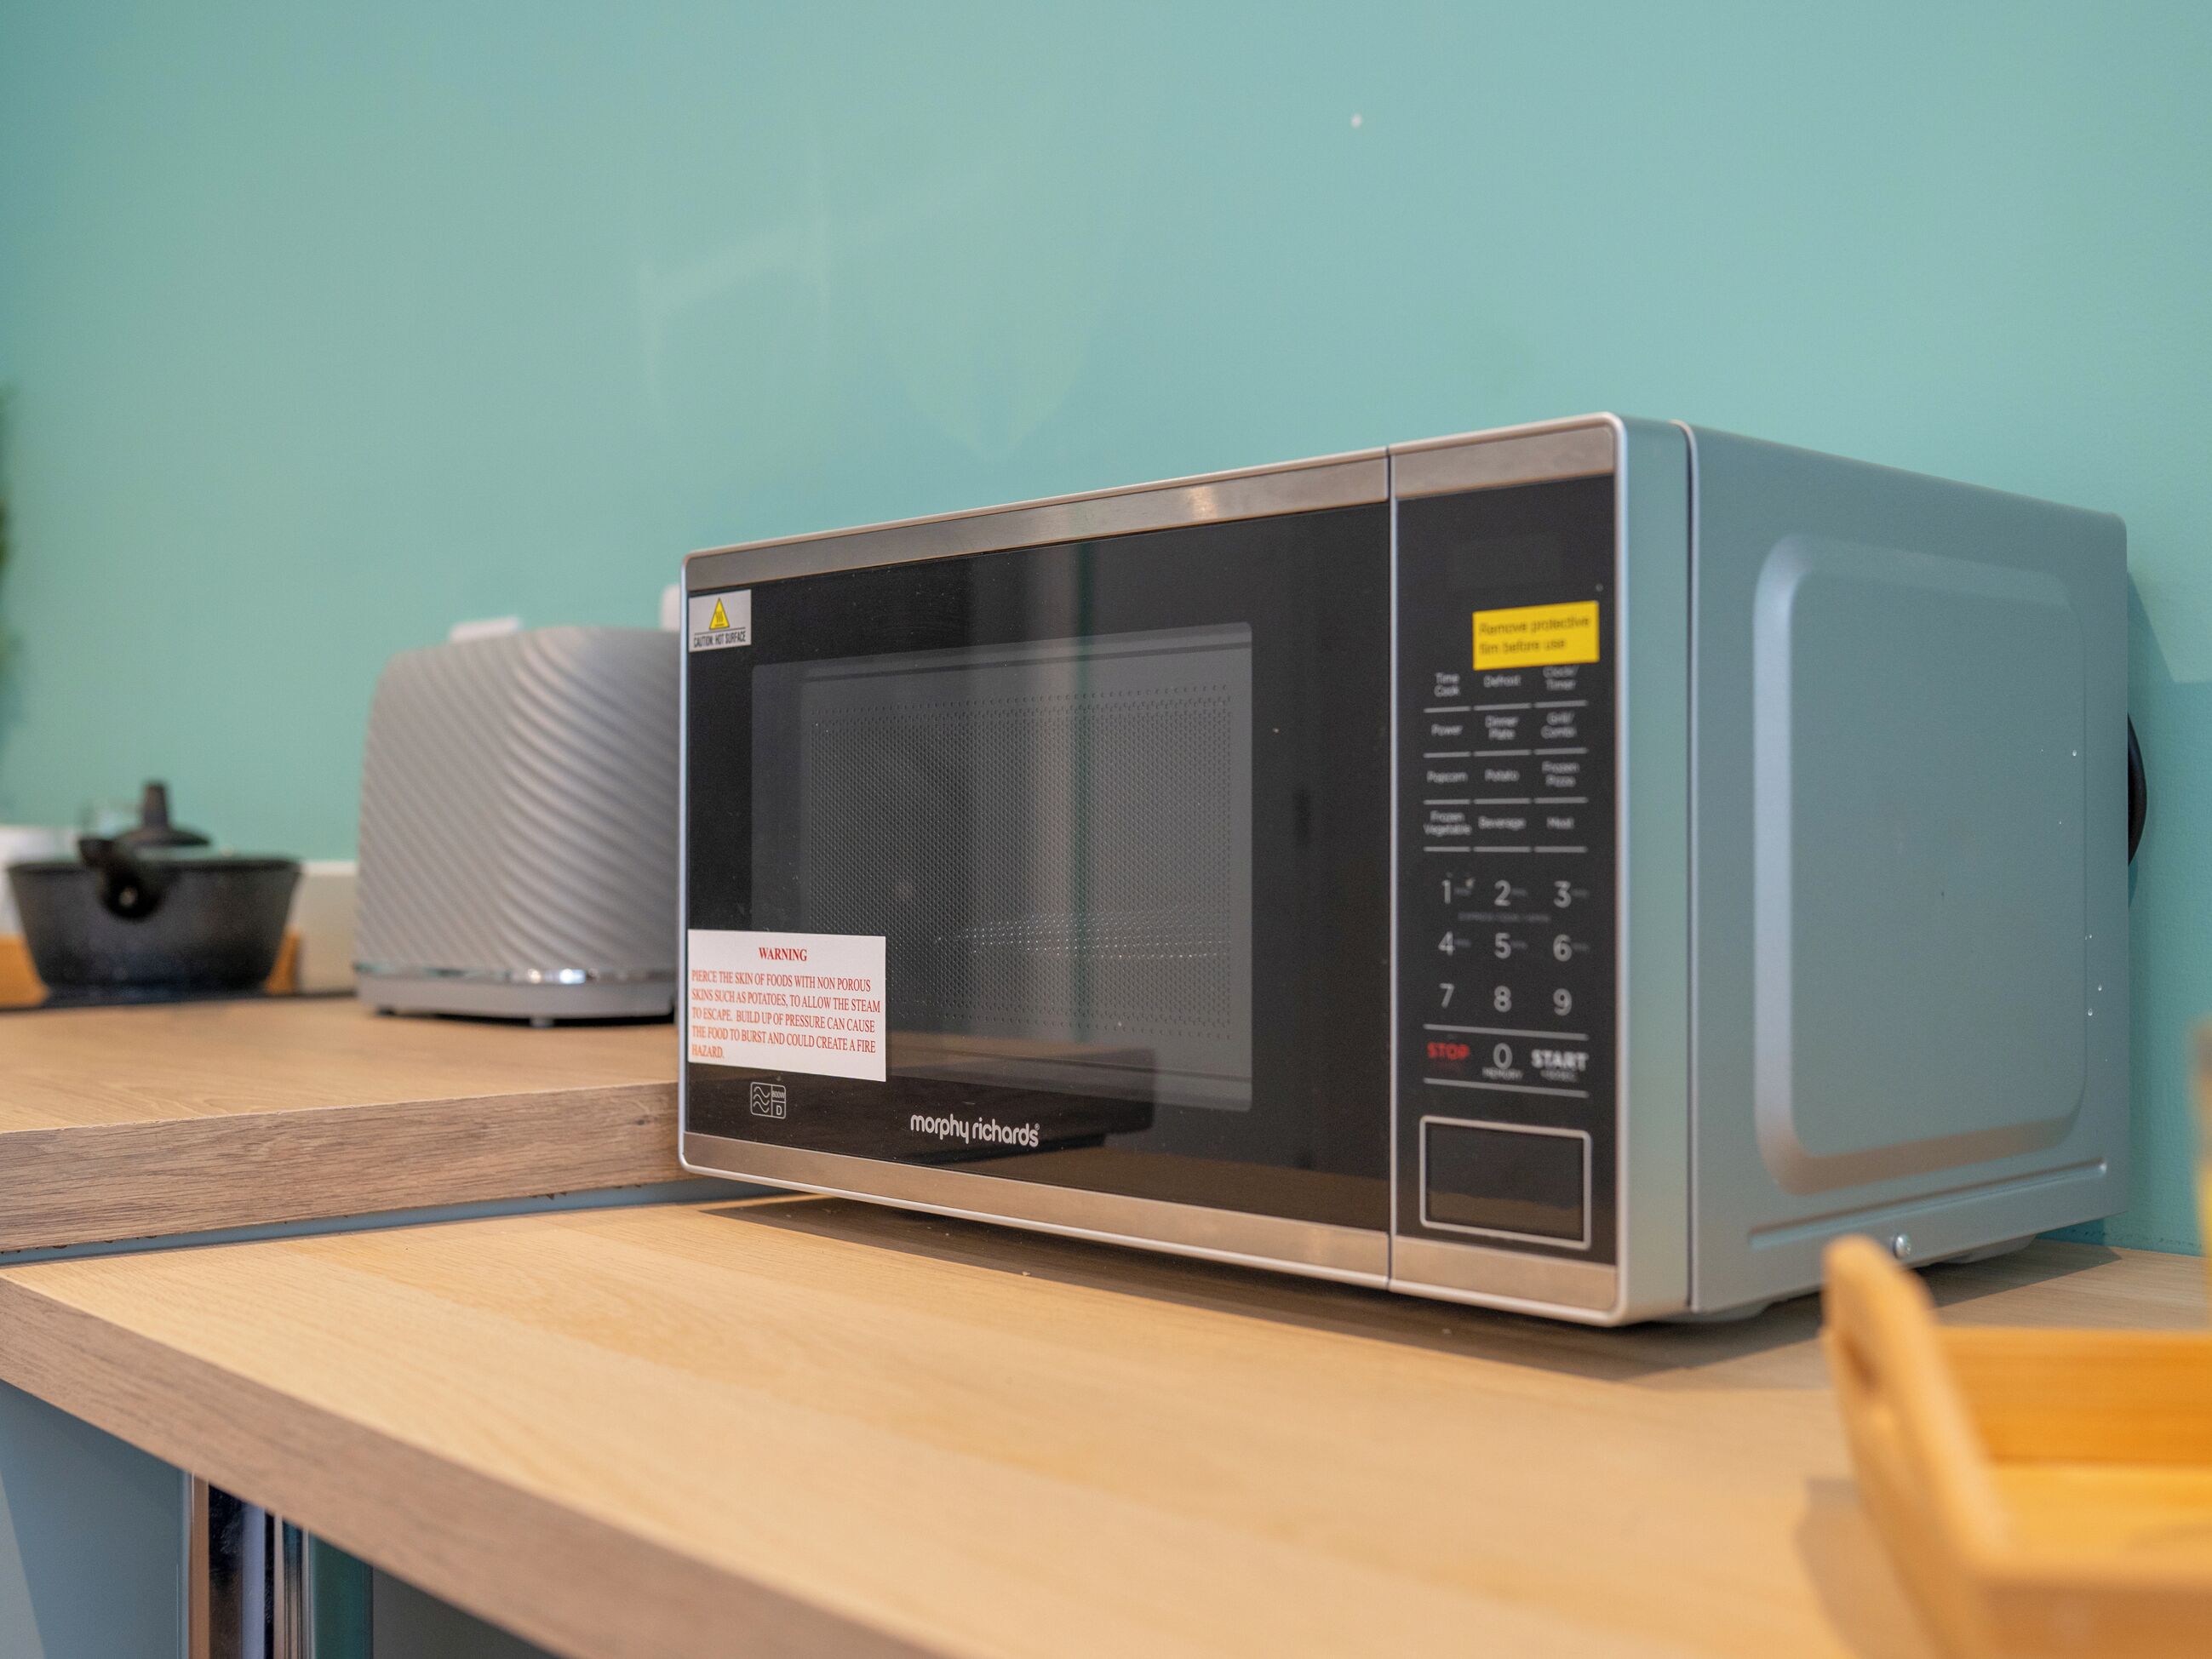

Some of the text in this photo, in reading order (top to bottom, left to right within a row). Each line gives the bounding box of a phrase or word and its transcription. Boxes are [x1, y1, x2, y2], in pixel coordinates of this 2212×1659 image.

[725, 631, 746, 644] SURFACE
[1479, 616, 1590, 636] Remove protective
[1504, 640, 1539, 653] before
[1544, 640, 1565, 650] use
[1431, 724, 1464, 736] Power
[1426, 770, 1469, 784] Popcorn
[1484, 769, 1520, 782] Potato
[1478, 815, 1527, 831] Beverage
[1441, 879, 1451, 904] 1
[1494, 879, 1511, 907] 2
[1553, 880, 1572, 908] 3
[758, 947, 807, 962] WARNING
[1438, 930, 1455, 957] 4
[1494, 932, 1511, 959] 5
[1552, 934, 1573, 962] 6
[691, 970, 871, 992] PIERCE THE SKIN OF FOODS WITH NON POROUS
[691, 988, 880, 1013] SKINS SUCH AS POTATOES, TO ALLOW THE STEAM
[1439, 983, 1455, 1009] 7
[1493, 985, 1512, 1013] 8
[1553, 988, 1573, 1016] 9
[691, 1007, 875, 1033] TO ESCAPE. BUILD UP OF PRESSURE CAN CAUSE
[691, 1026, 876, 1053] THE FOOD TO BURST AND COULD CREATE A FIRE
[691, 1044, 725, 1059] HAZARD.
[1427, 1042, 1470, 1060] STOP
[1493, 1043, 1513, 1069] 0
[1531, 1049, 1589, 1072] START
[776, 1105, 782, 1115] D
[910, 1113, 969, 1144] morphy
